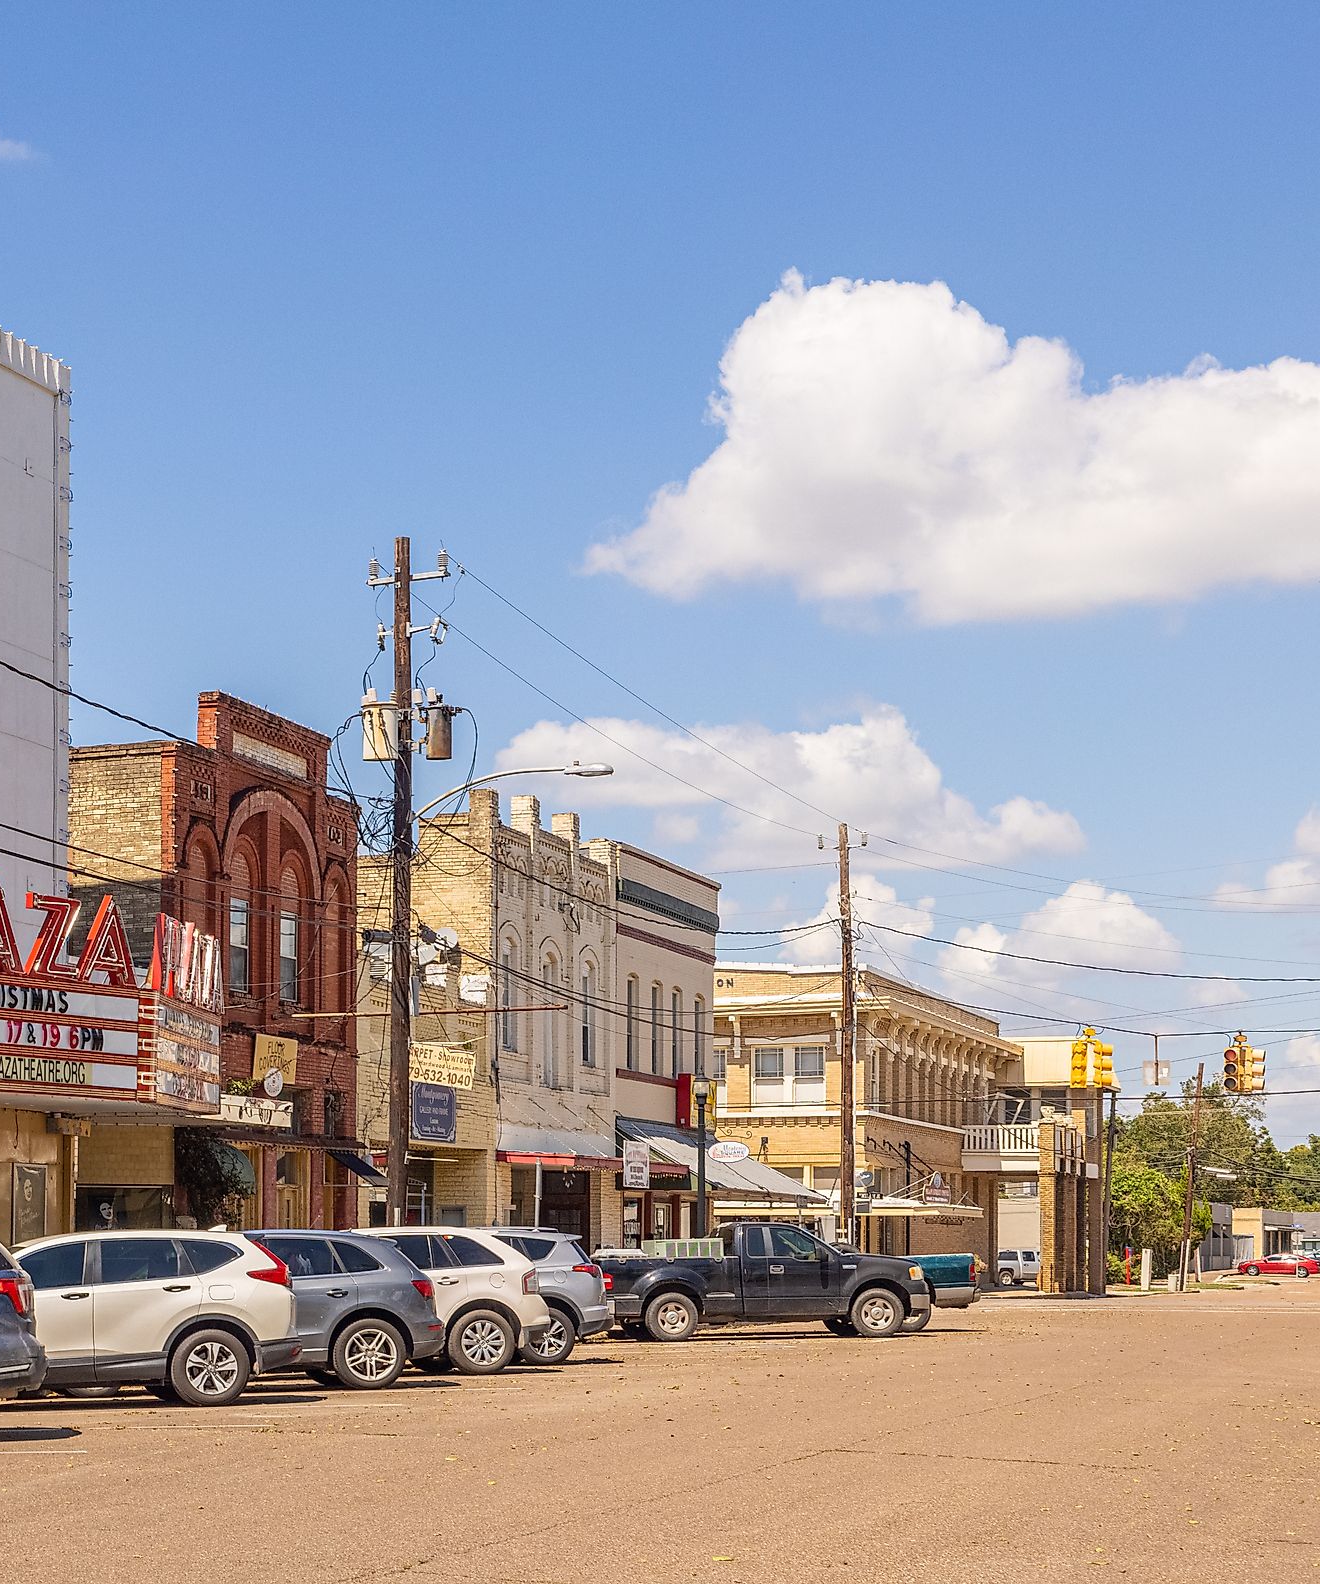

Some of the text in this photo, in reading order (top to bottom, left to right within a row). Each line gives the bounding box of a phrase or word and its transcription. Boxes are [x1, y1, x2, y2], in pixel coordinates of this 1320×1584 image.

[7, 1019, 23, 1043] 17
[27, 1022, 36, 1044] &
[42, 1022, 60, 1047] 19
[409, 1045, 434, 1060] ARPET
[409, 1066, 471, 1087] 79-532-1040
